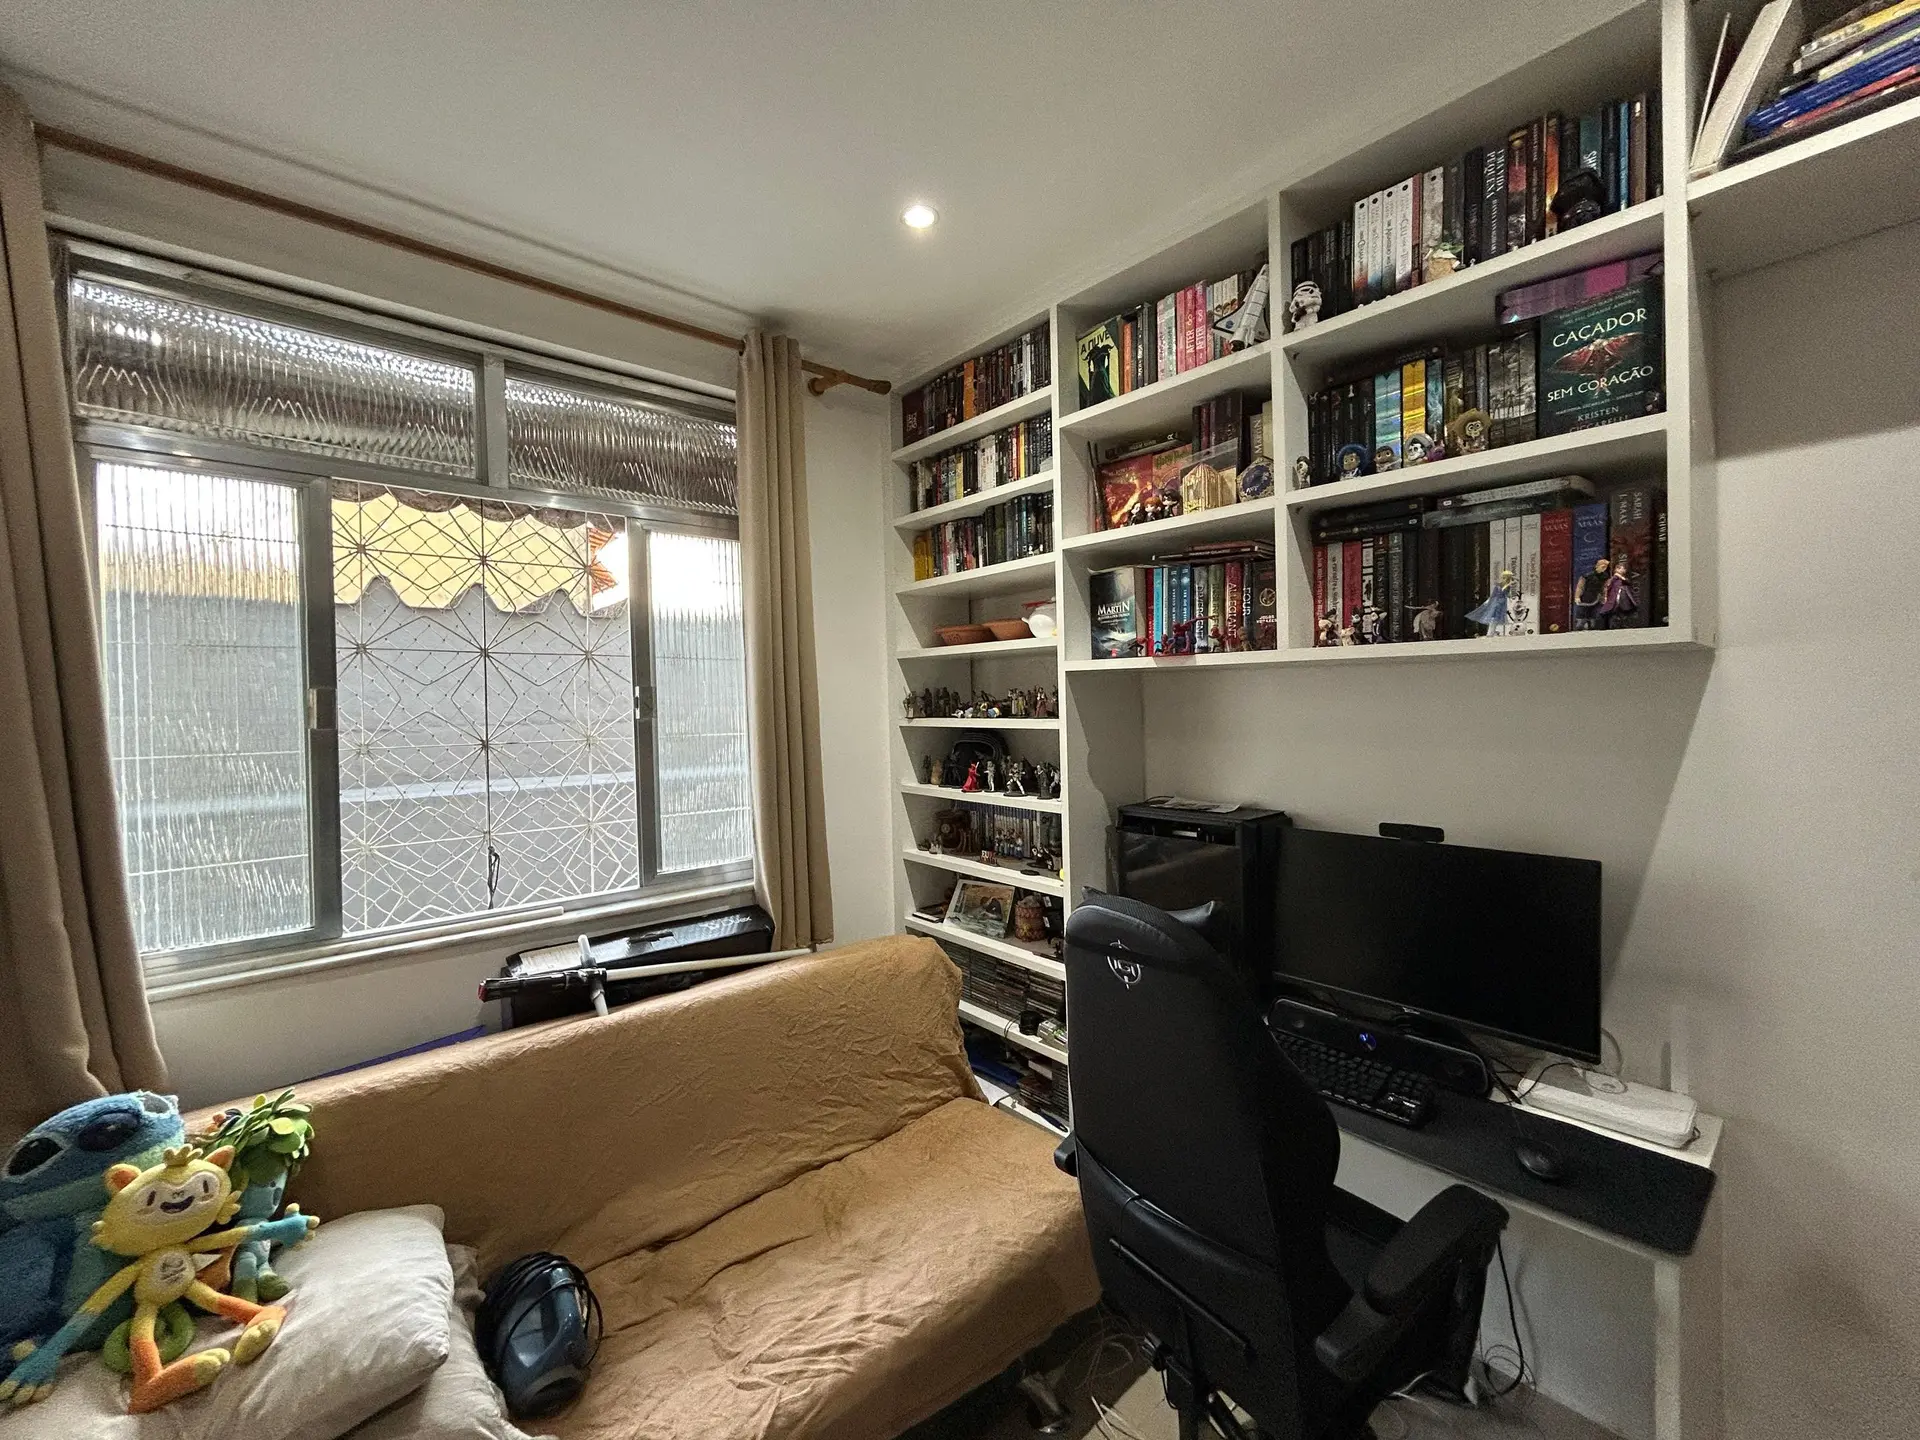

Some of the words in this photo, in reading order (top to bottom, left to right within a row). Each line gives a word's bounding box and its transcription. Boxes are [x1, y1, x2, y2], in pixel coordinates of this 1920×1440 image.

[1484, 150, 1496, 199] PEQUENA
[1496, 169, 1505, 192] VIDA
[1186, 329, 1195, 353] AFTER
[1196, 325, 1205, 350] AFTER
[1552, 307, 1648, 348] CAÇADOR
[1080, 343, 1087, 355] A
[1547, 385, 1573, 402] SEM
[1577, 364, 1654, 392] CORAÇÃO
[1577, 405, 1620, 422] KRISTEN
[1254, 419, 1263, 454] MARTIN
[1619, 501, 1628, 525] MAAS
[1633, 491, 1642, 520] SARAH
[1577, 518, 1604, 529] MAAS
[1658, 513, 1667, 542] SCHWAB
[1097, 599, 1130, 618] MARTIN
[1228, 583, 1238, 638] ALLEGIANT
[1242, 587, 1252, 616] FOUR
